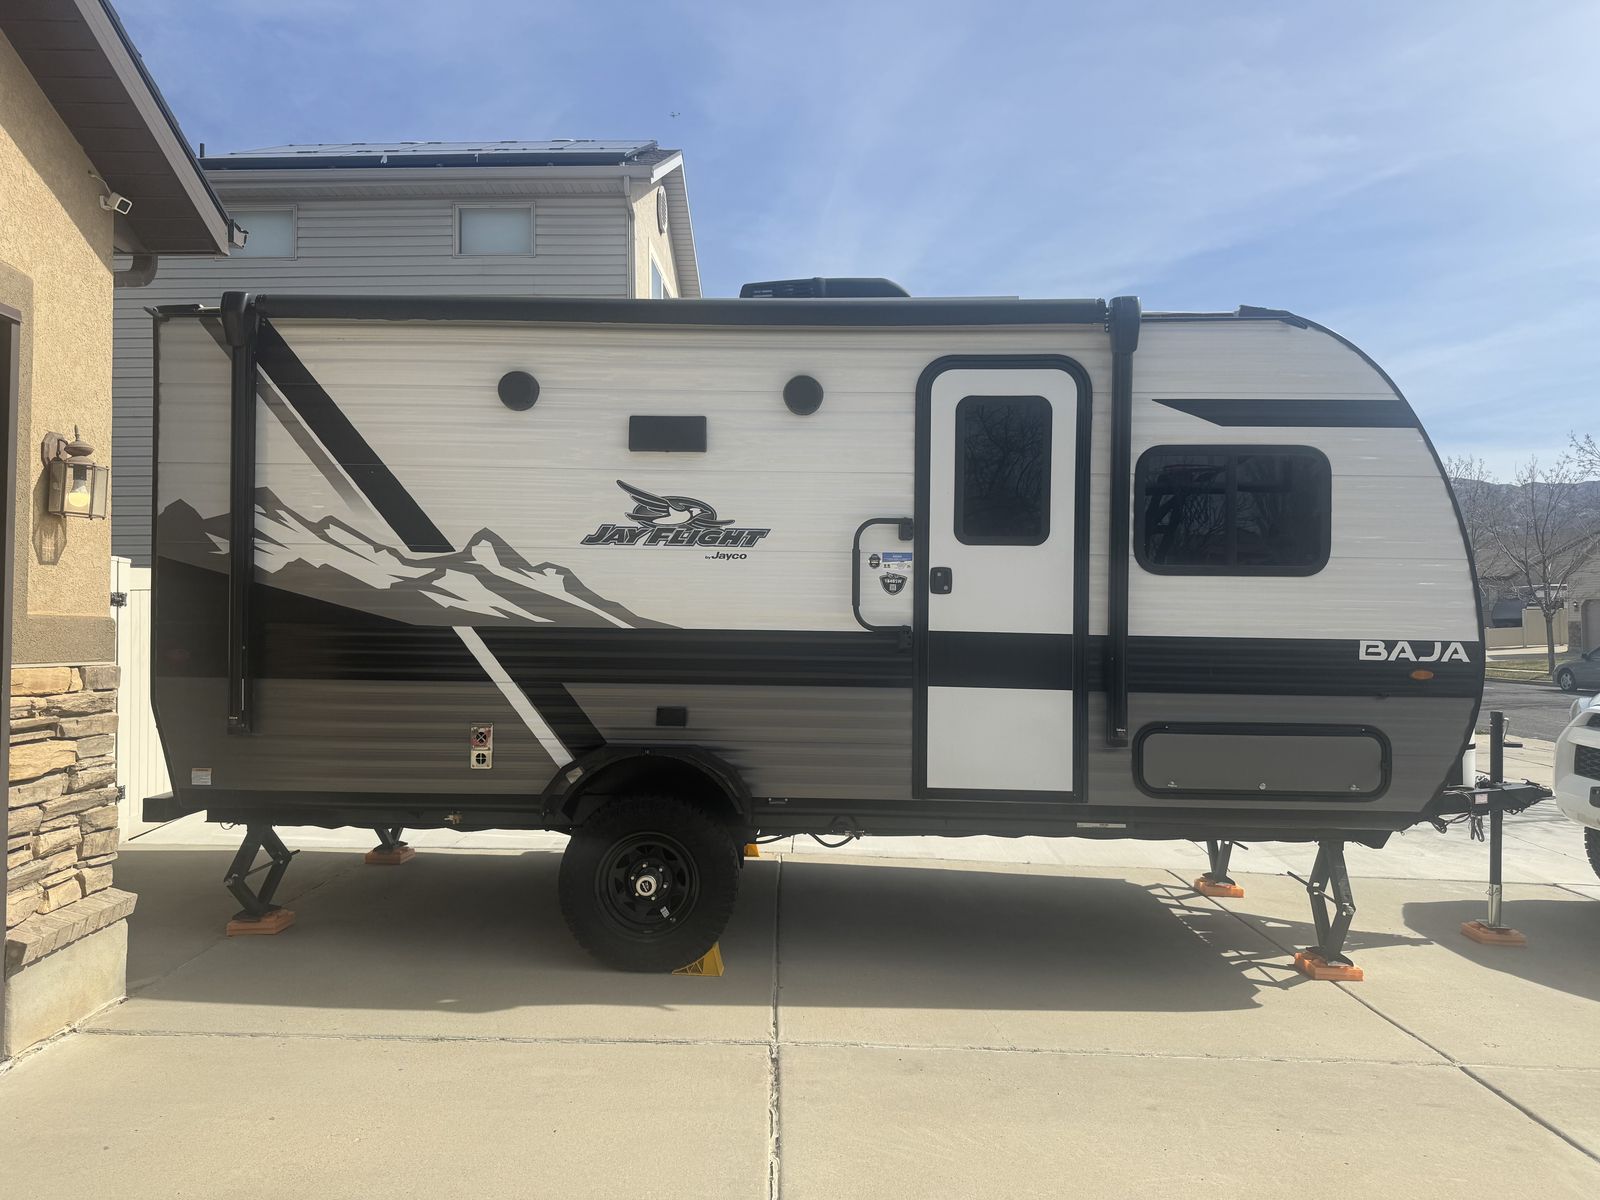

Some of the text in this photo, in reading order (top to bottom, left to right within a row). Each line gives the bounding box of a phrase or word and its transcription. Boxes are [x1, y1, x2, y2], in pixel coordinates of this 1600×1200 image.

[580, 524, 772, 547] JAY FLIGHT
[711, 551, 748, 561] Jayco
[1359, 640, 1471, 662] BAJA
